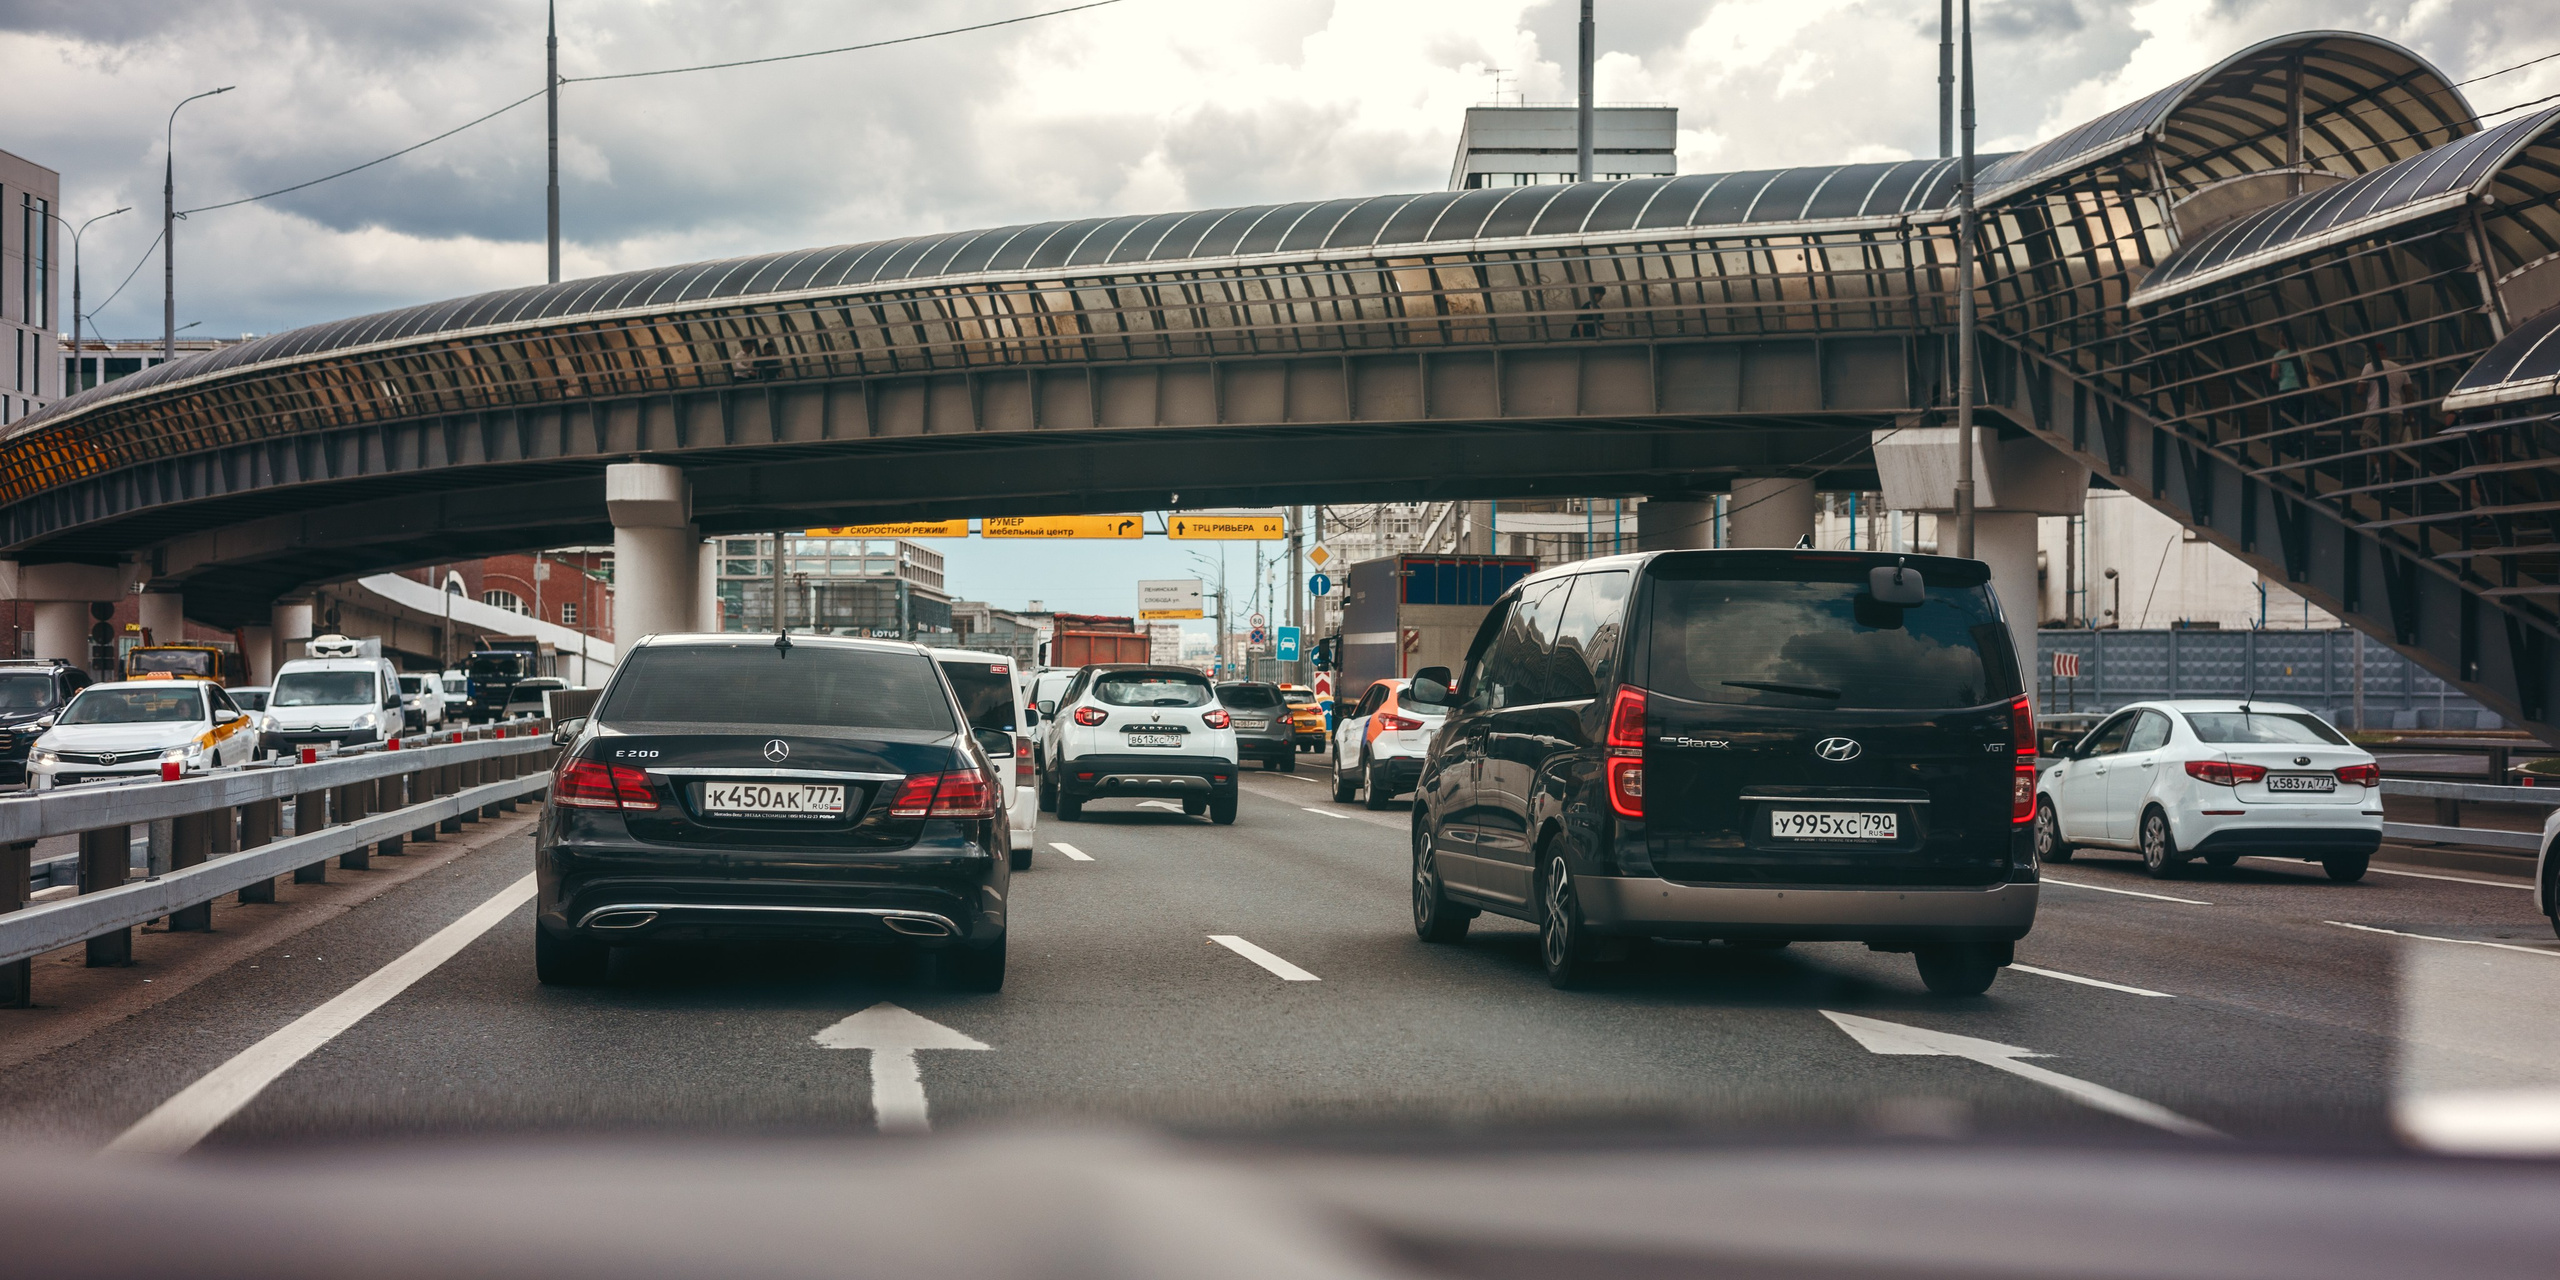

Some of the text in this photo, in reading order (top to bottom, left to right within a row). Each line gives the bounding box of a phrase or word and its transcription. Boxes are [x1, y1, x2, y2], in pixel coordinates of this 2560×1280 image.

[989, 518, 1024, 526] РУМЕР
[850, 526, 948, 535] СКОРОСТНОЙ РЕЖИМ!
[989, 523, 1113, 537] мебельный центр 1
[1193, 524, 1276, 532] ТРЦ РИВЬЕРА 0.4
[872, 630, 900, 638] LOTUS
[1677, 737, 1730, 749] Starex
[1983, 743, 2006, 752] VGT
[2314, 778, 2331, 787] 777
[805, 786, 839, 803] 777
[1862, 815, 1892, 830] 790
